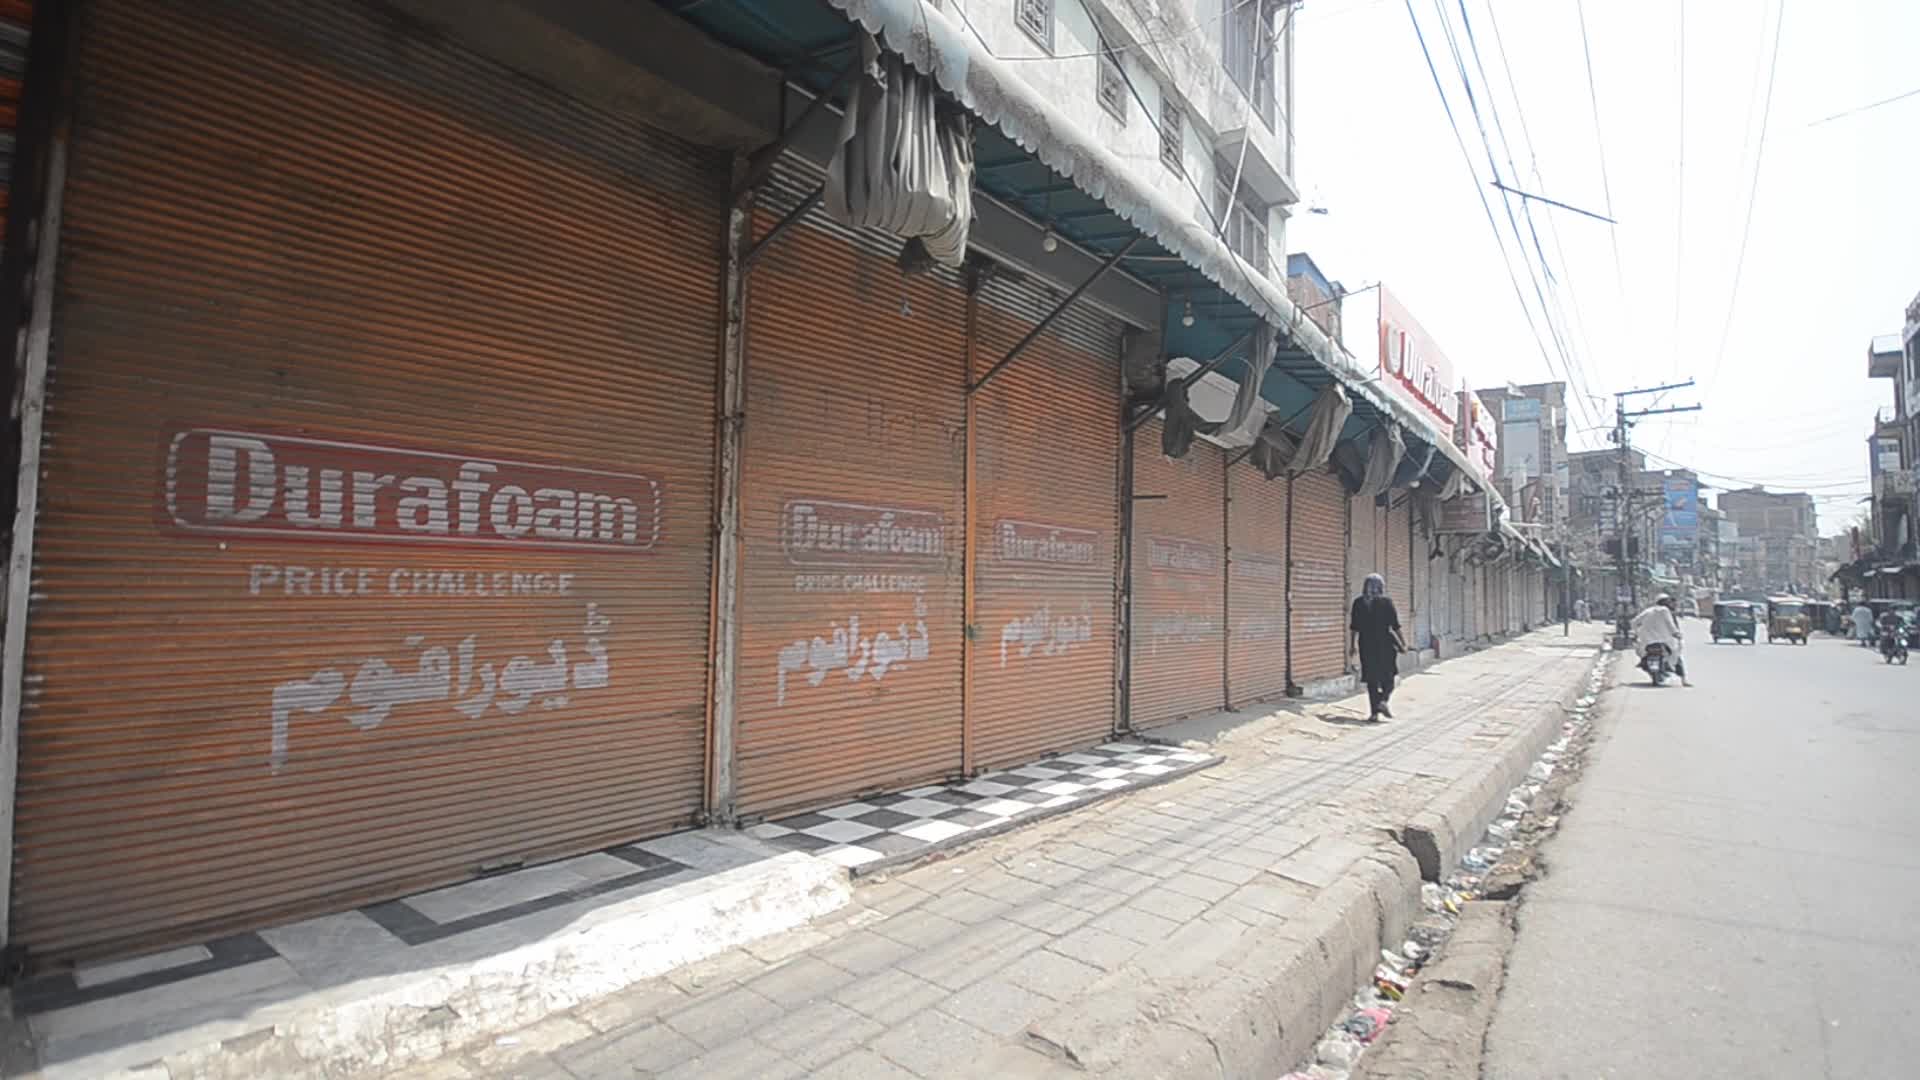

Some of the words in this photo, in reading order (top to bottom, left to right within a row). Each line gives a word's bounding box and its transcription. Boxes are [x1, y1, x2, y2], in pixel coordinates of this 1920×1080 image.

[205, 434, 638, 543] Durafoam
[793, 504, 941, 554] Durafoam
[250, 563, 377, 597] PRICE
[388, 567, 576, 597] CHALLENGE
